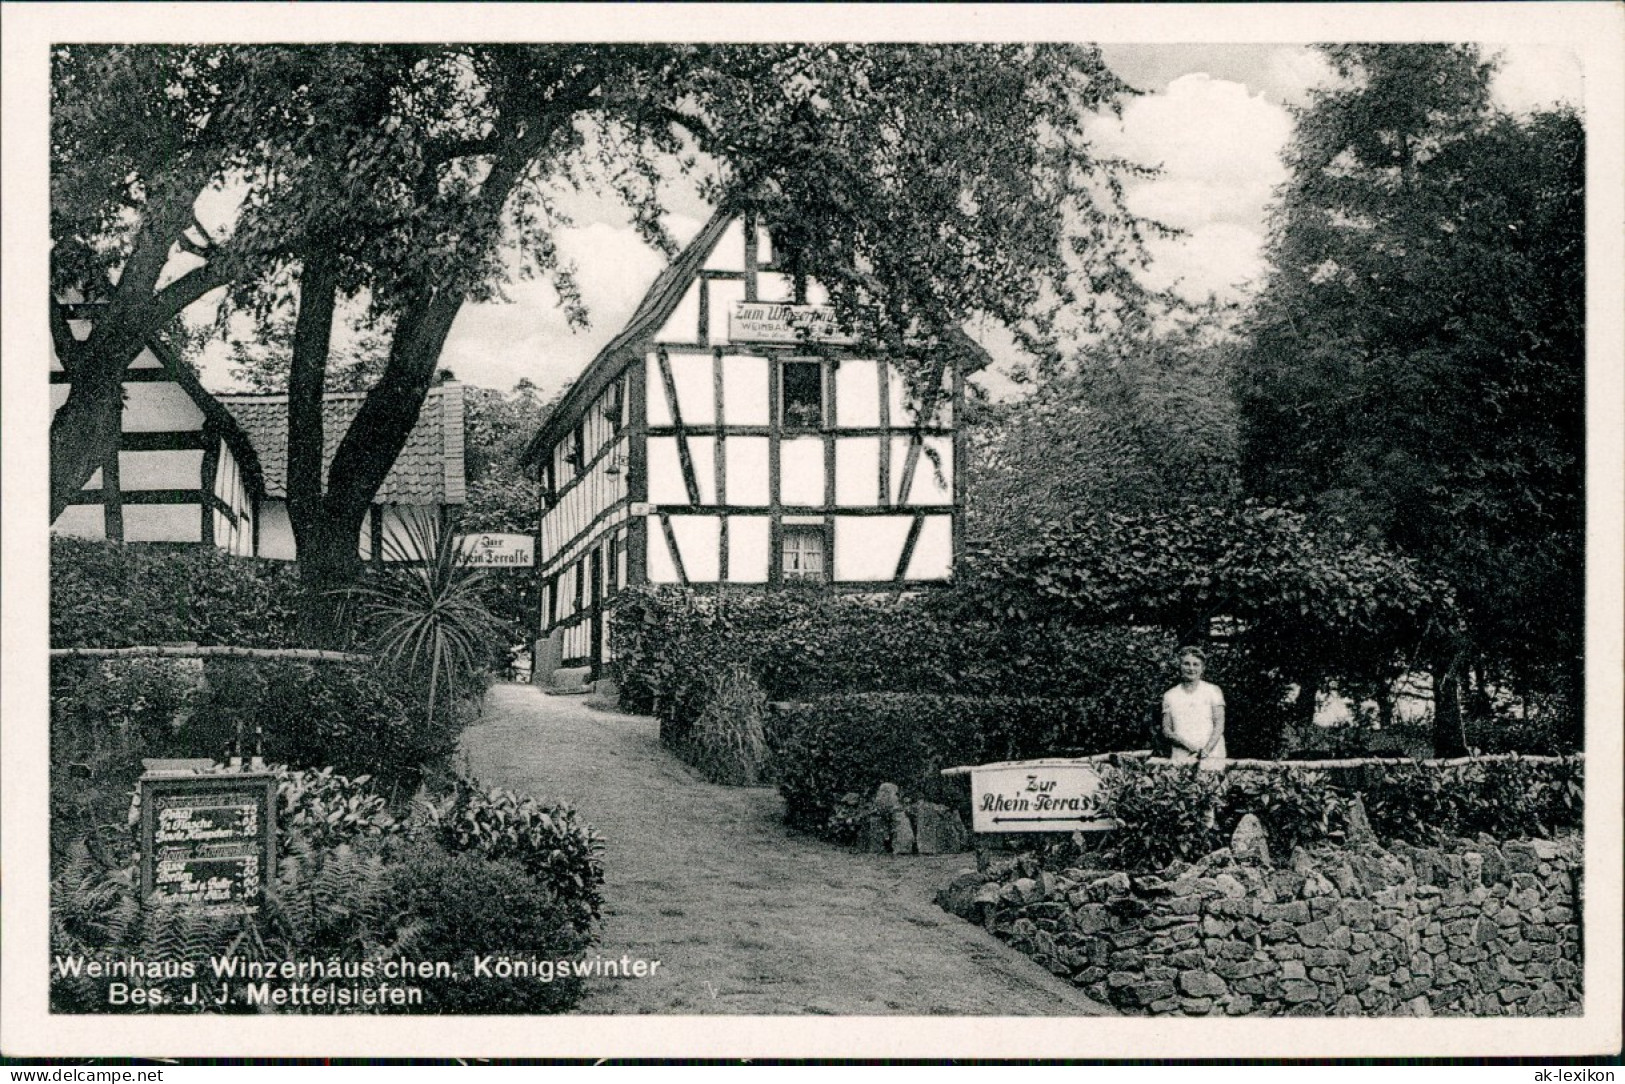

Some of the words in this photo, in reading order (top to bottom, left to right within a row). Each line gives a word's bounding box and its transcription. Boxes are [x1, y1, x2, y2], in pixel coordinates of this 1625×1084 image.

[735, 305, 764, 320] Zum
[1025, 775, 1057, 792] Zur
[979, 791, 1102, 812] Rhein-Terrass
